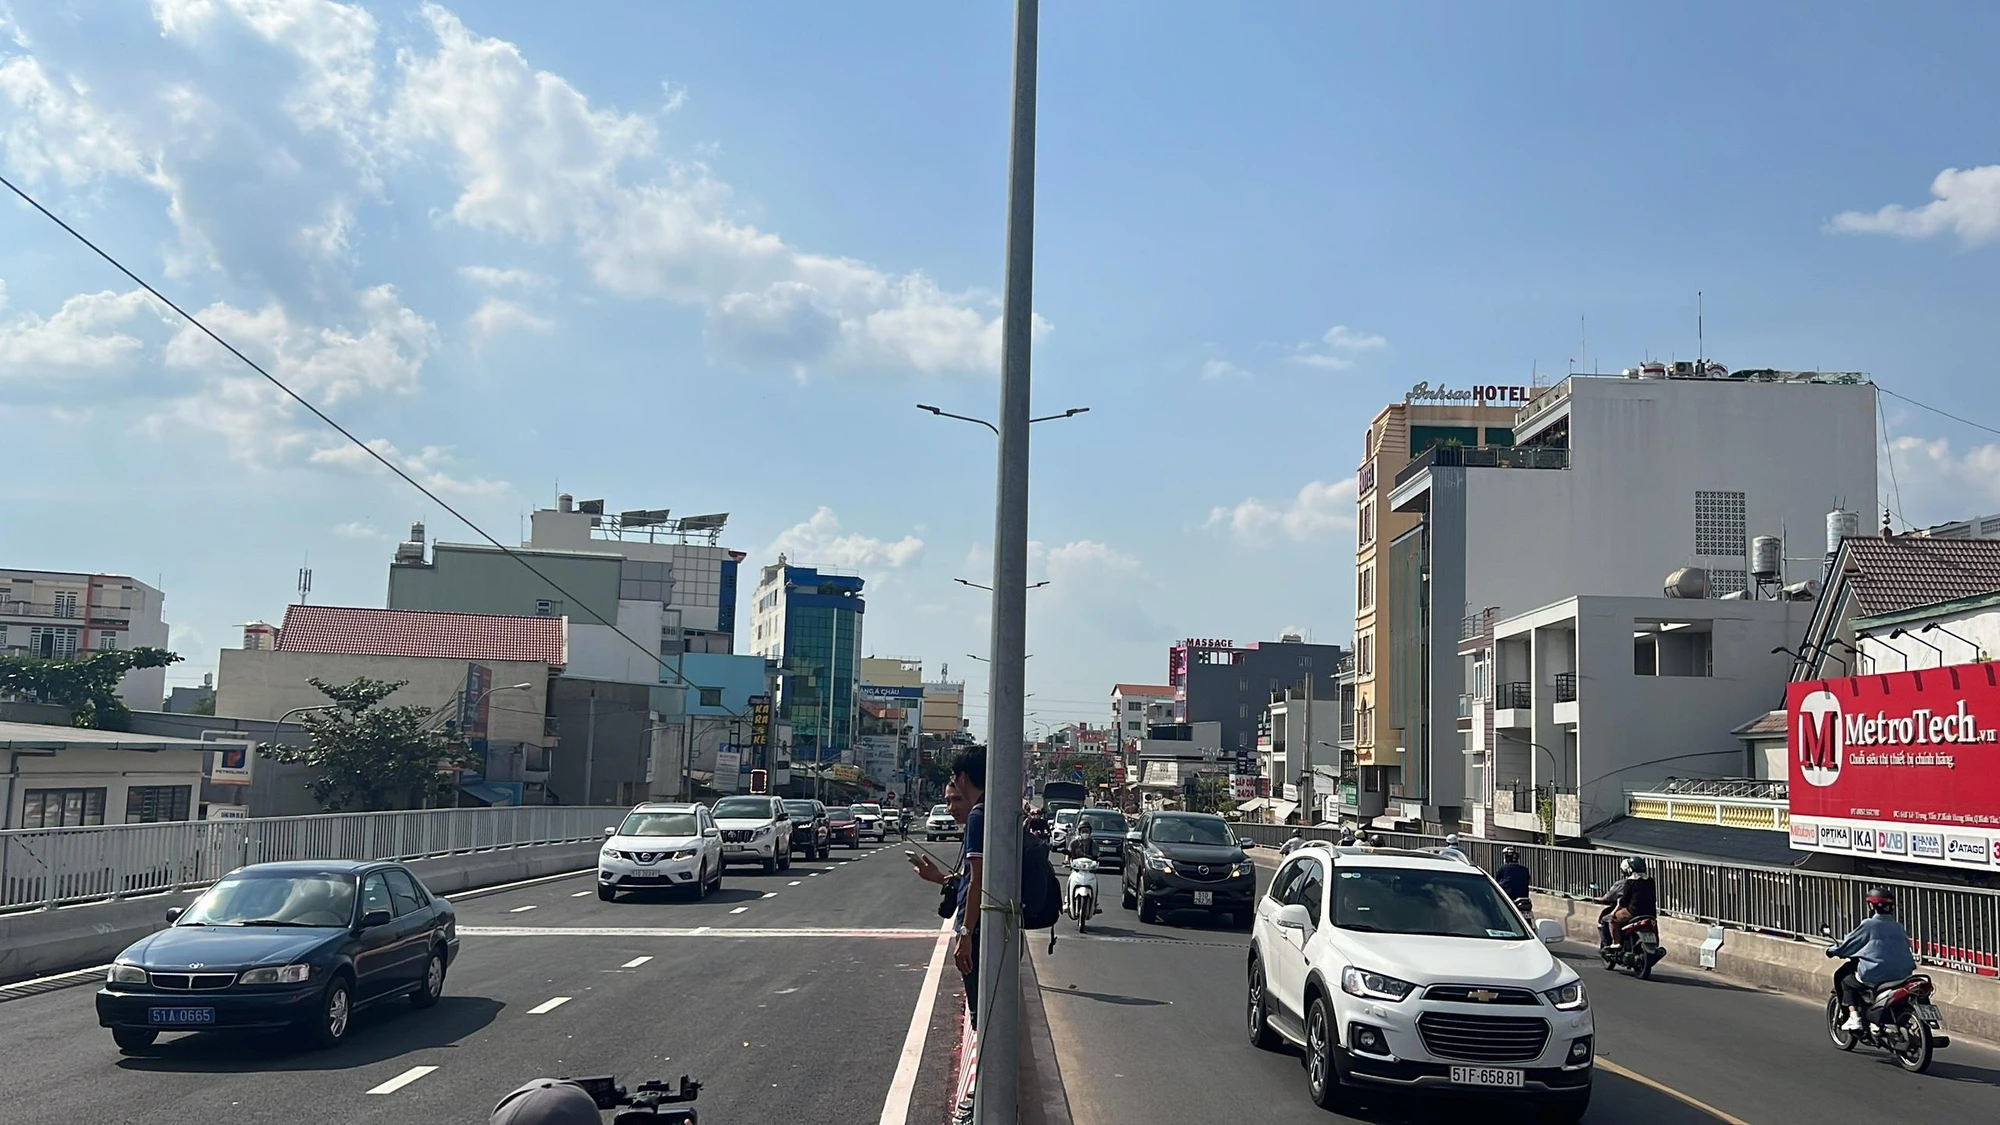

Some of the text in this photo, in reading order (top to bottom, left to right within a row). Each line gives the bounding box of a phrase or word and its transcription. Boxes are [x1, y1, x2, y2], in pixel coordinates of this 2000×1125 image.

[1473, 385, 1530, 401] HOTEL
[1187, 638, 1233, 647] MASSAGE
[1845, 700, 1998, 745] MetroTech.vn
[1799, 711, 1839, 772] M
[1821, 828, 1847, 839] OPTIKA
[1854, 831, 1872, 847] IKA
[1918, 835, 1940, 847] HANNA
[1958, 844, 1985, 854] ATAGO
[153, 1009, 211, 1022] 51A 0665
[1452, 1067, 1521, 1086] 51F-658.81
